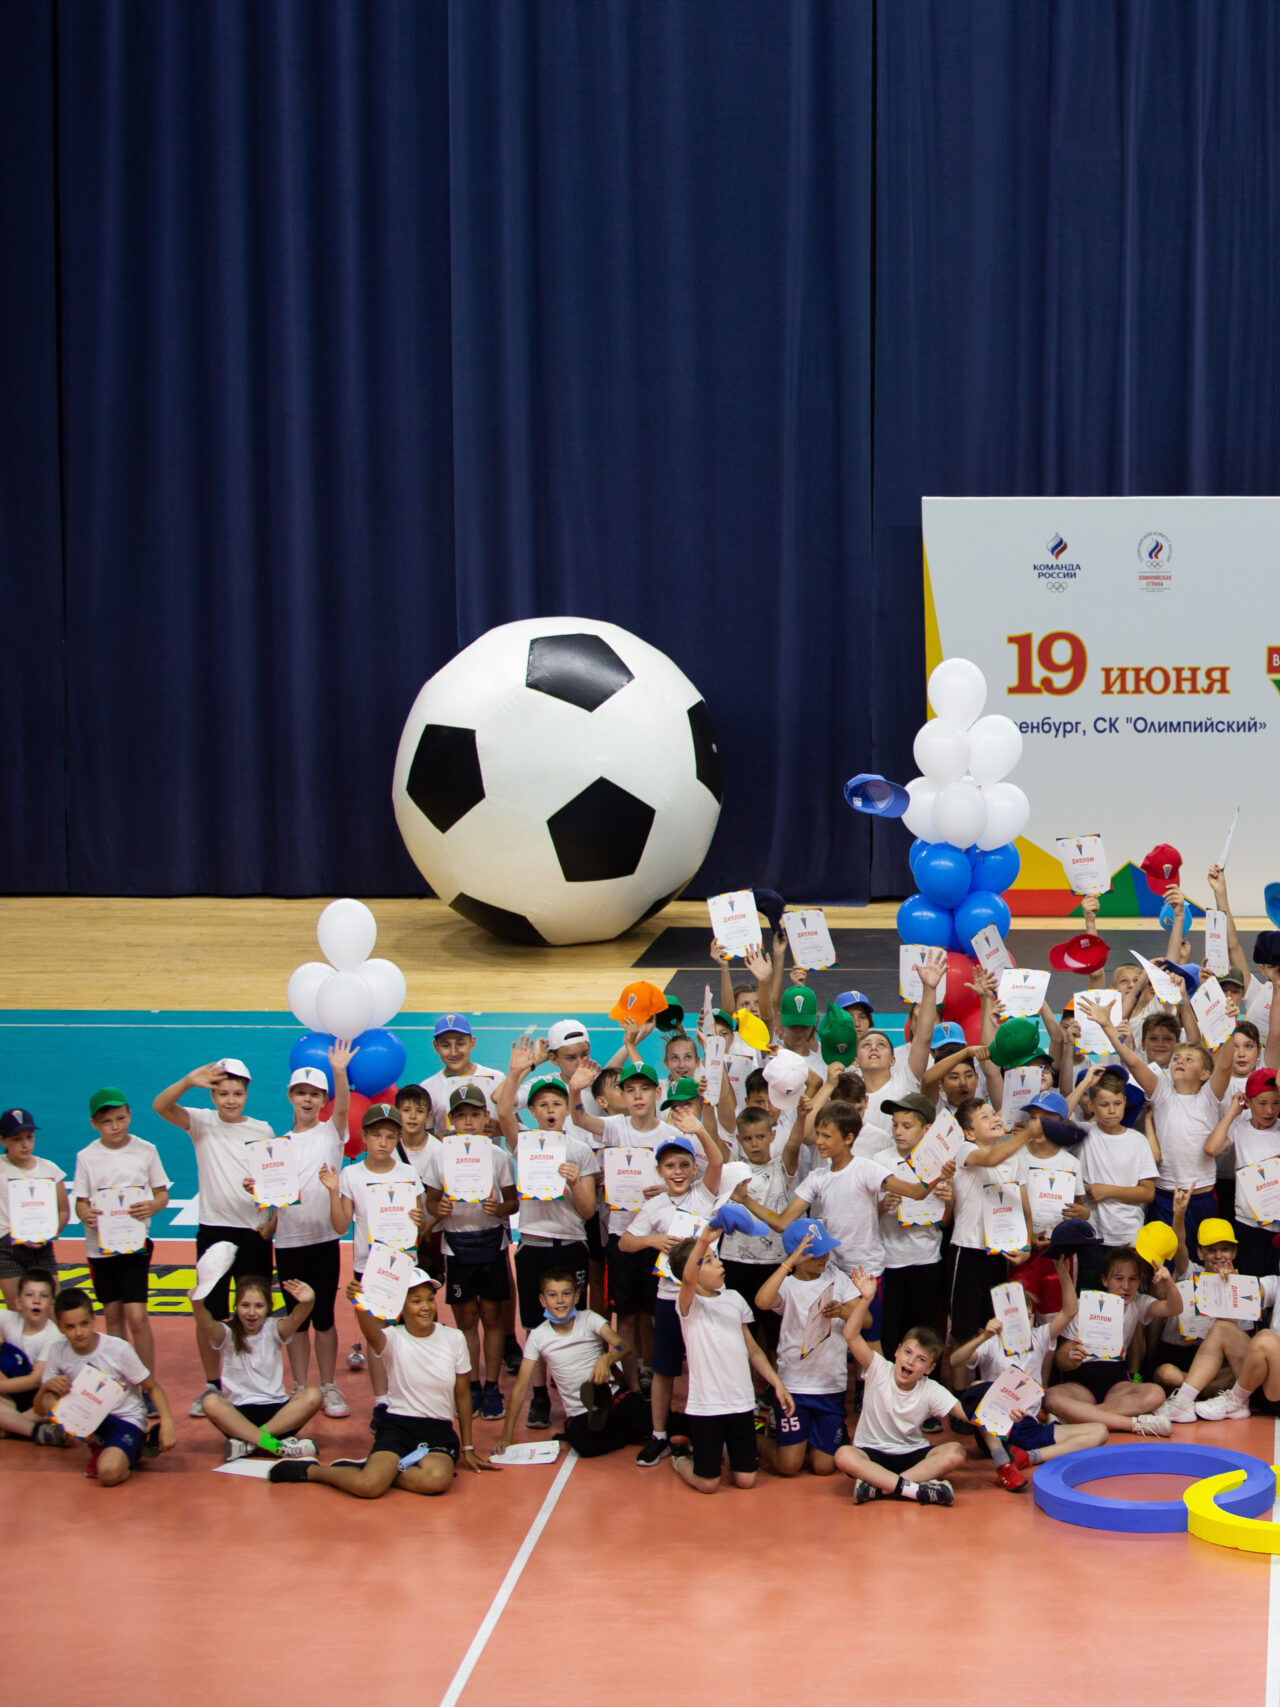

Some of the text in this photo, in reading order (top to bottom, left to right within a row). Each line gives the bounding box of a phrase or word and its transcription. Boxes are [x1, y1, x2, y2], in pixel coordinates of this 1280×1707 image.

[1033, 564, 1081, 572] КОМАНДА
[1006, 630, 1089, 696] 19
[1015, 716, 1087, 738] енбург,
[1093, 717, 1120, 734] СК
[780, 1416, 801, 1432] 55
